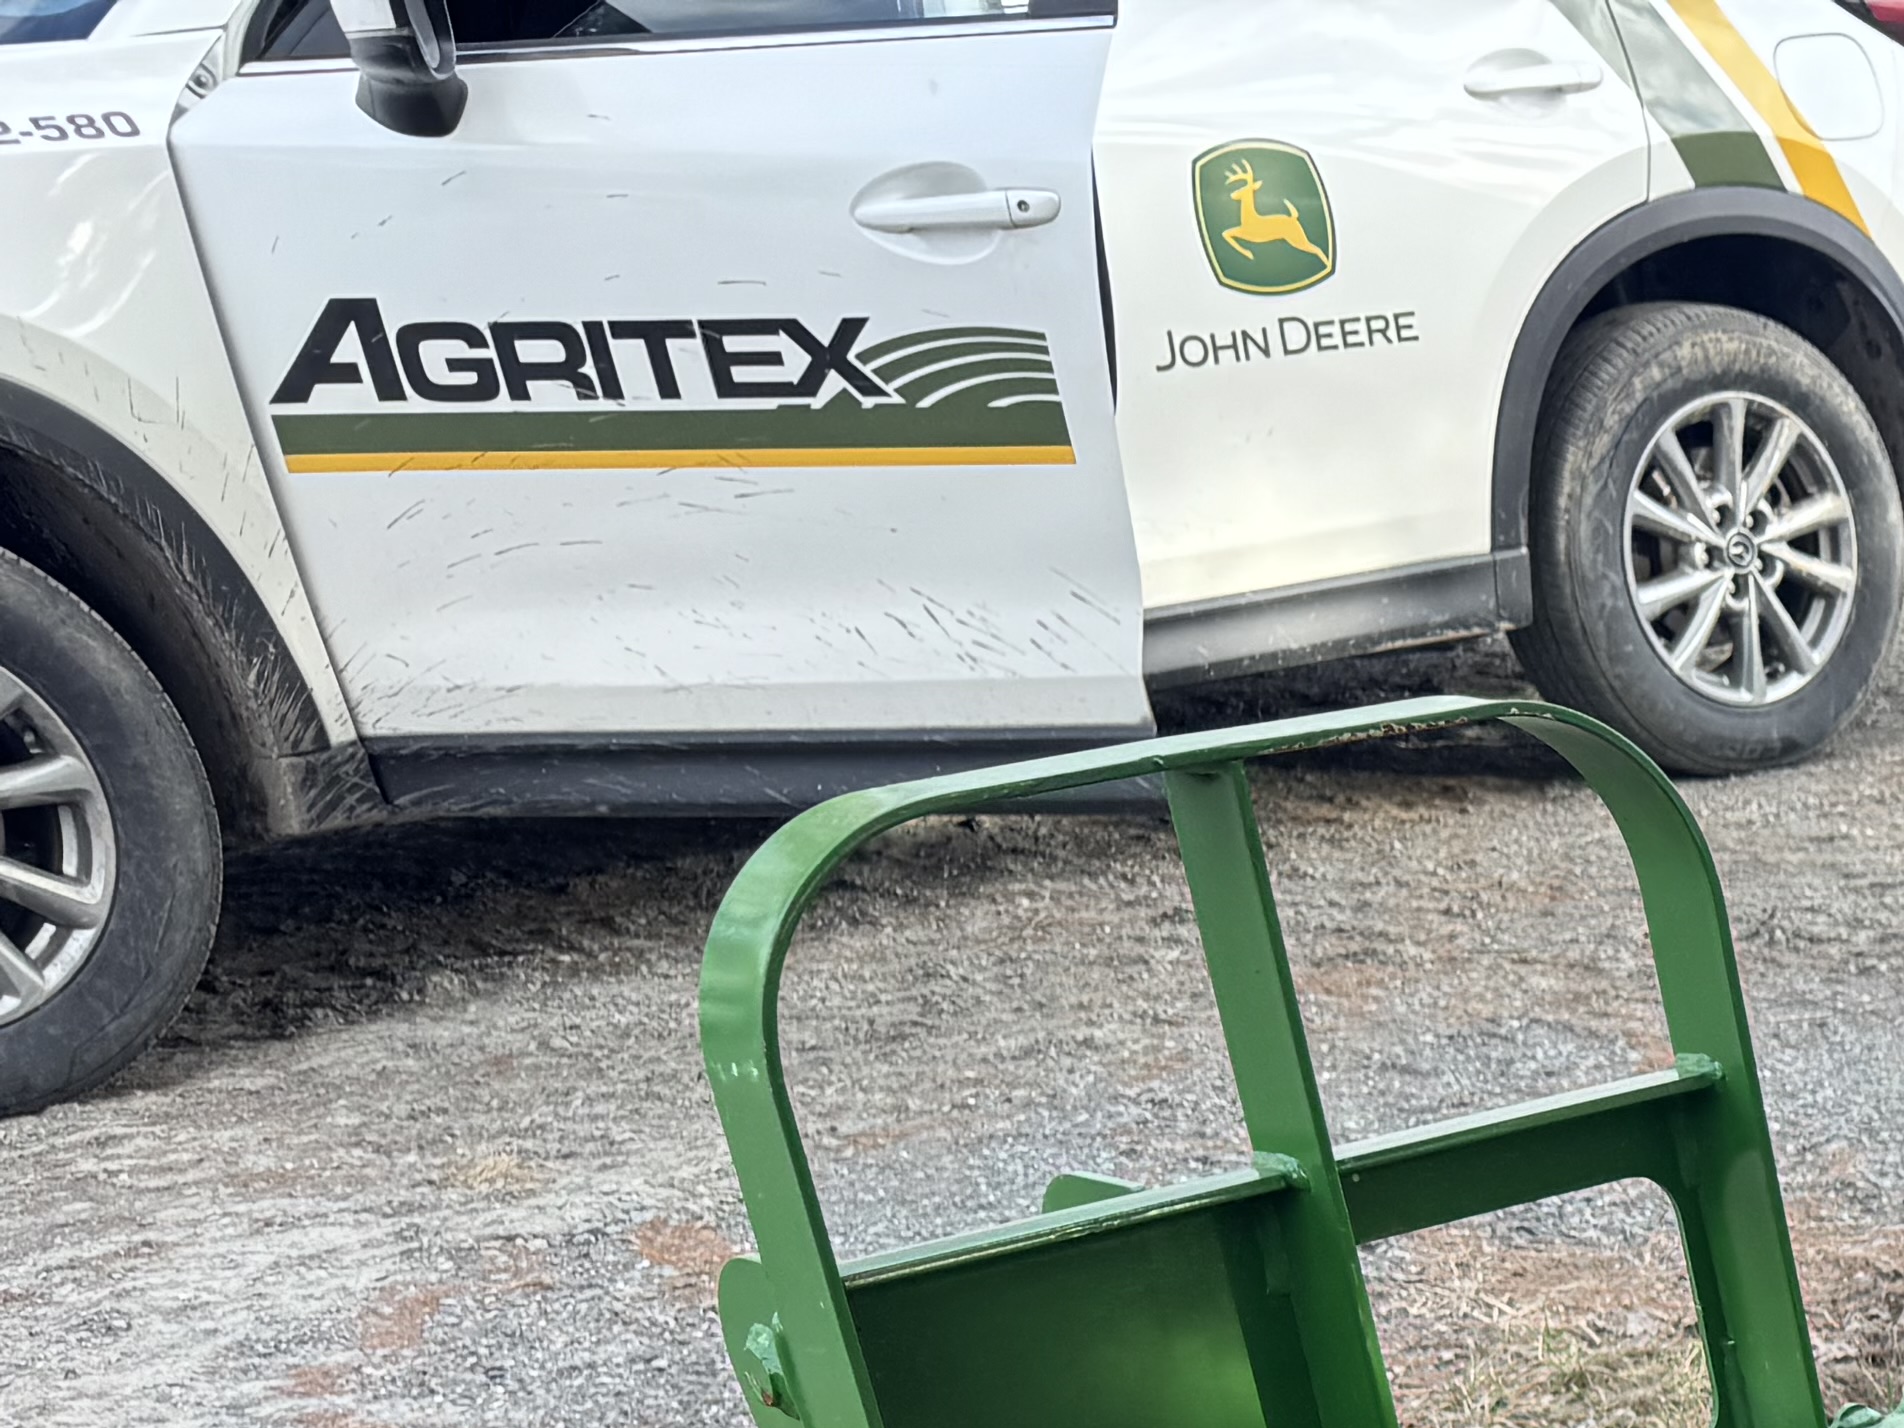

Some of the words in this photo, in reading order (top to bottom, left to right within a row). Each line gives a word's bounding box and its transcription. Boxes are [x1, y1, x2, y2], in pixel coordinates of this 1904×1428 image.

[272, 297, 898, 404] AGRITEX
[1155, 326, 1271, 372] JOHN
[1277, 310, 1420, 357] DEERE
